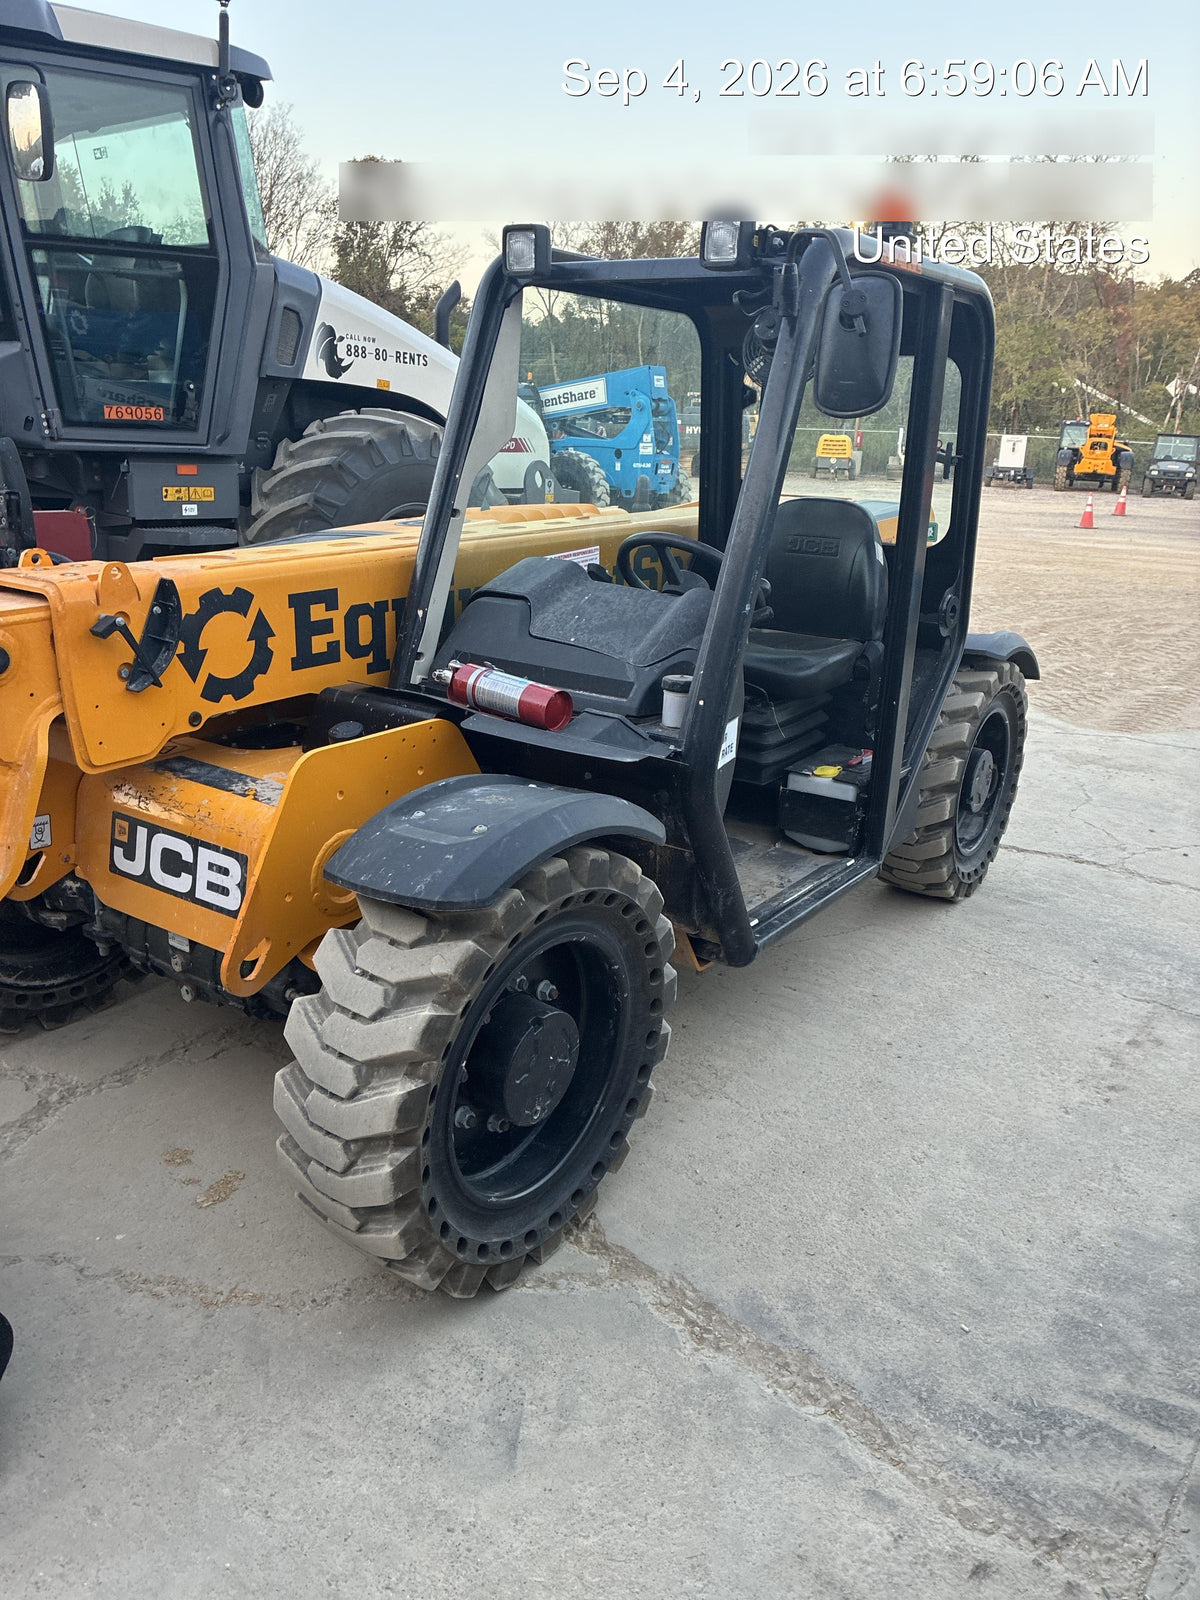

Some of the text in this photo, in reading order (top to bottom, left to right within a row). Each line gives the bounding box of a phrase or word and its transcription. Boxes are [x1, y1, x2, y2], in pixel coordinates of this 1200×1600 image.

[345, 333, 377, 344] CALL NOW
[346, 343, 429, 367] 888-80-RENTS
[104, 405, 163, 420] 769056
[113, 825, 242, 911] JCB
